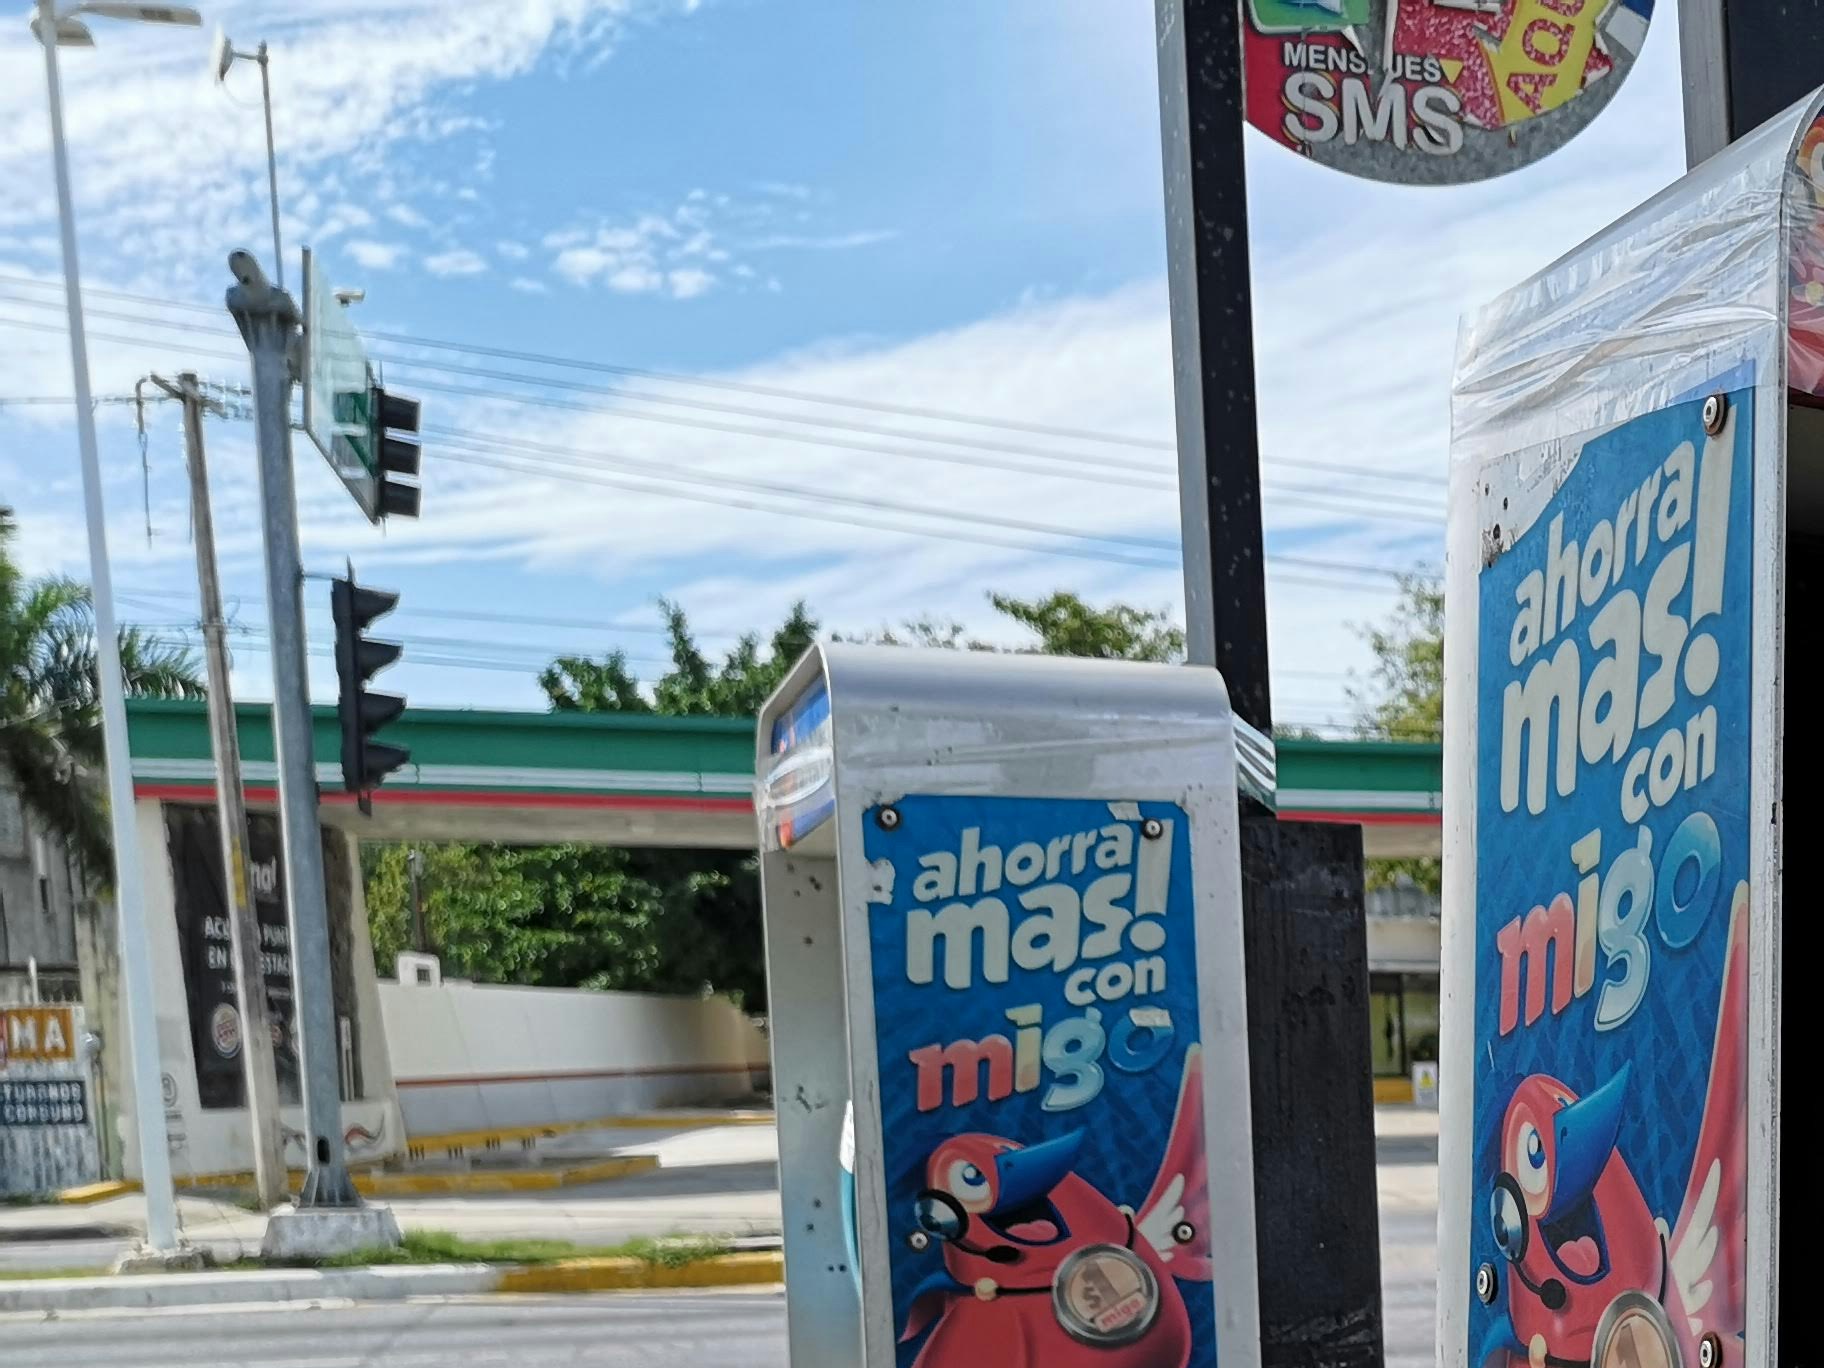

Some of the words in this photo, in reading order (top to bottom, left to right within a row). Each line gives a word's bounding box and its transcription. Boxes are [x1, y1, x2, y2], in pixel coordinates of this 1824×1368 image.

[1284, 41, 1441, 82] MENSJES
[1283, 71, 1464, 155] SMS
[1509, 440, 1696, 668] ahorra
[1620, 704, 1717, 824] con
[913, 823, 1134, 902] ahorra
[1497, 811, 1721, 1037] migo
[1064, 956, 1166, 1007] con
[909, 1003, 1176, 1112] migo
